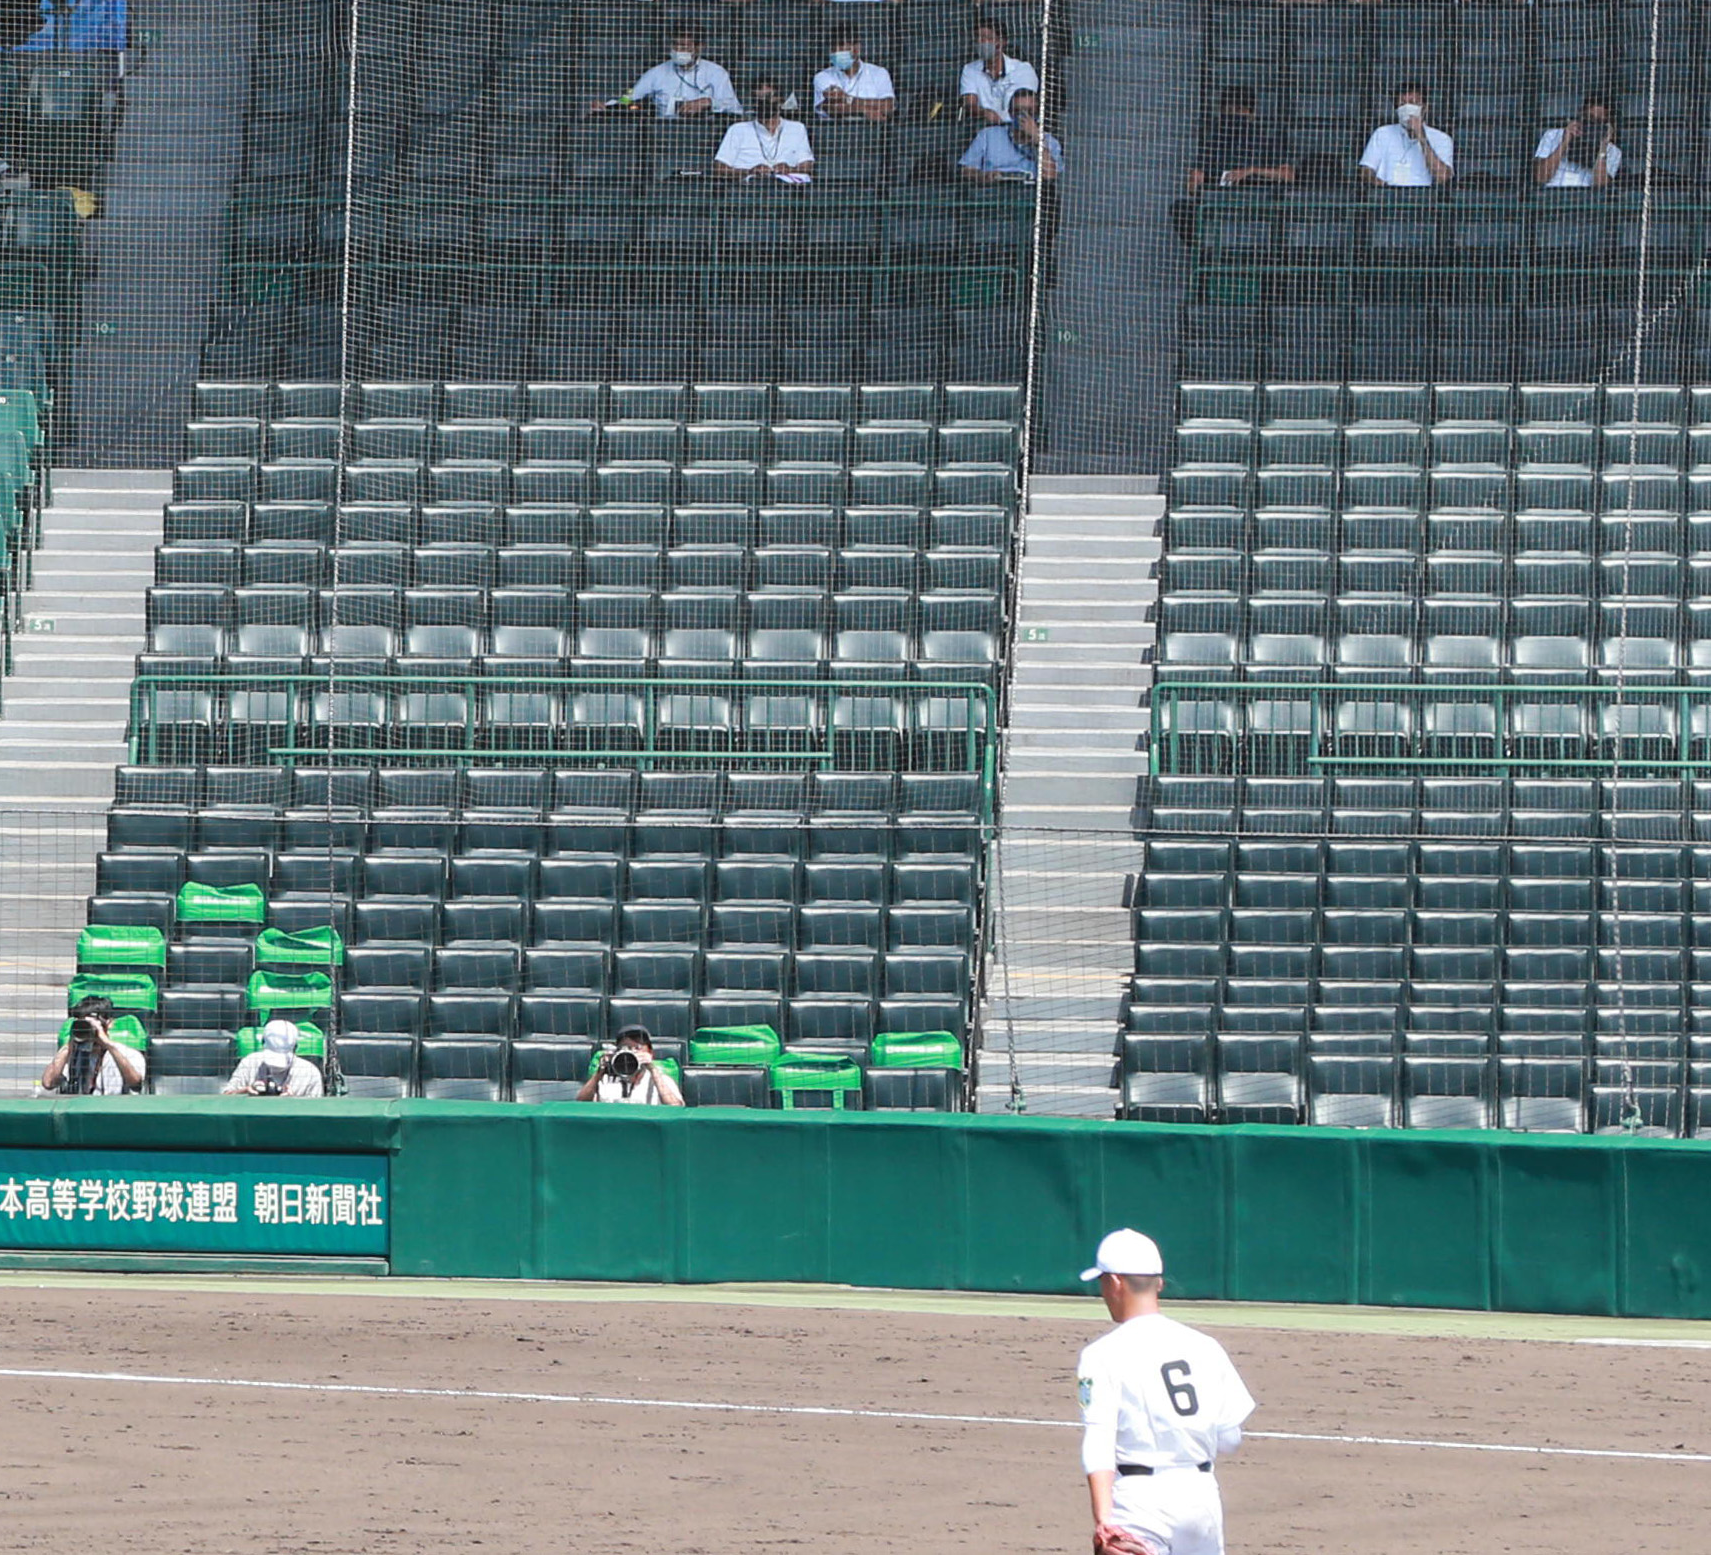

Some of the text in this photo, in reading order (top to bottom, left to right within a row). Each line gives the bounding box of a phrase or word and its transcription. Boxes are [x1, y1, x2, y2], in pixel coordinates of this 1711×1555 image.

[253, 1182, 383, 1226] 朝日新聞社
[1160, 1359, 1199, 1416] 6
